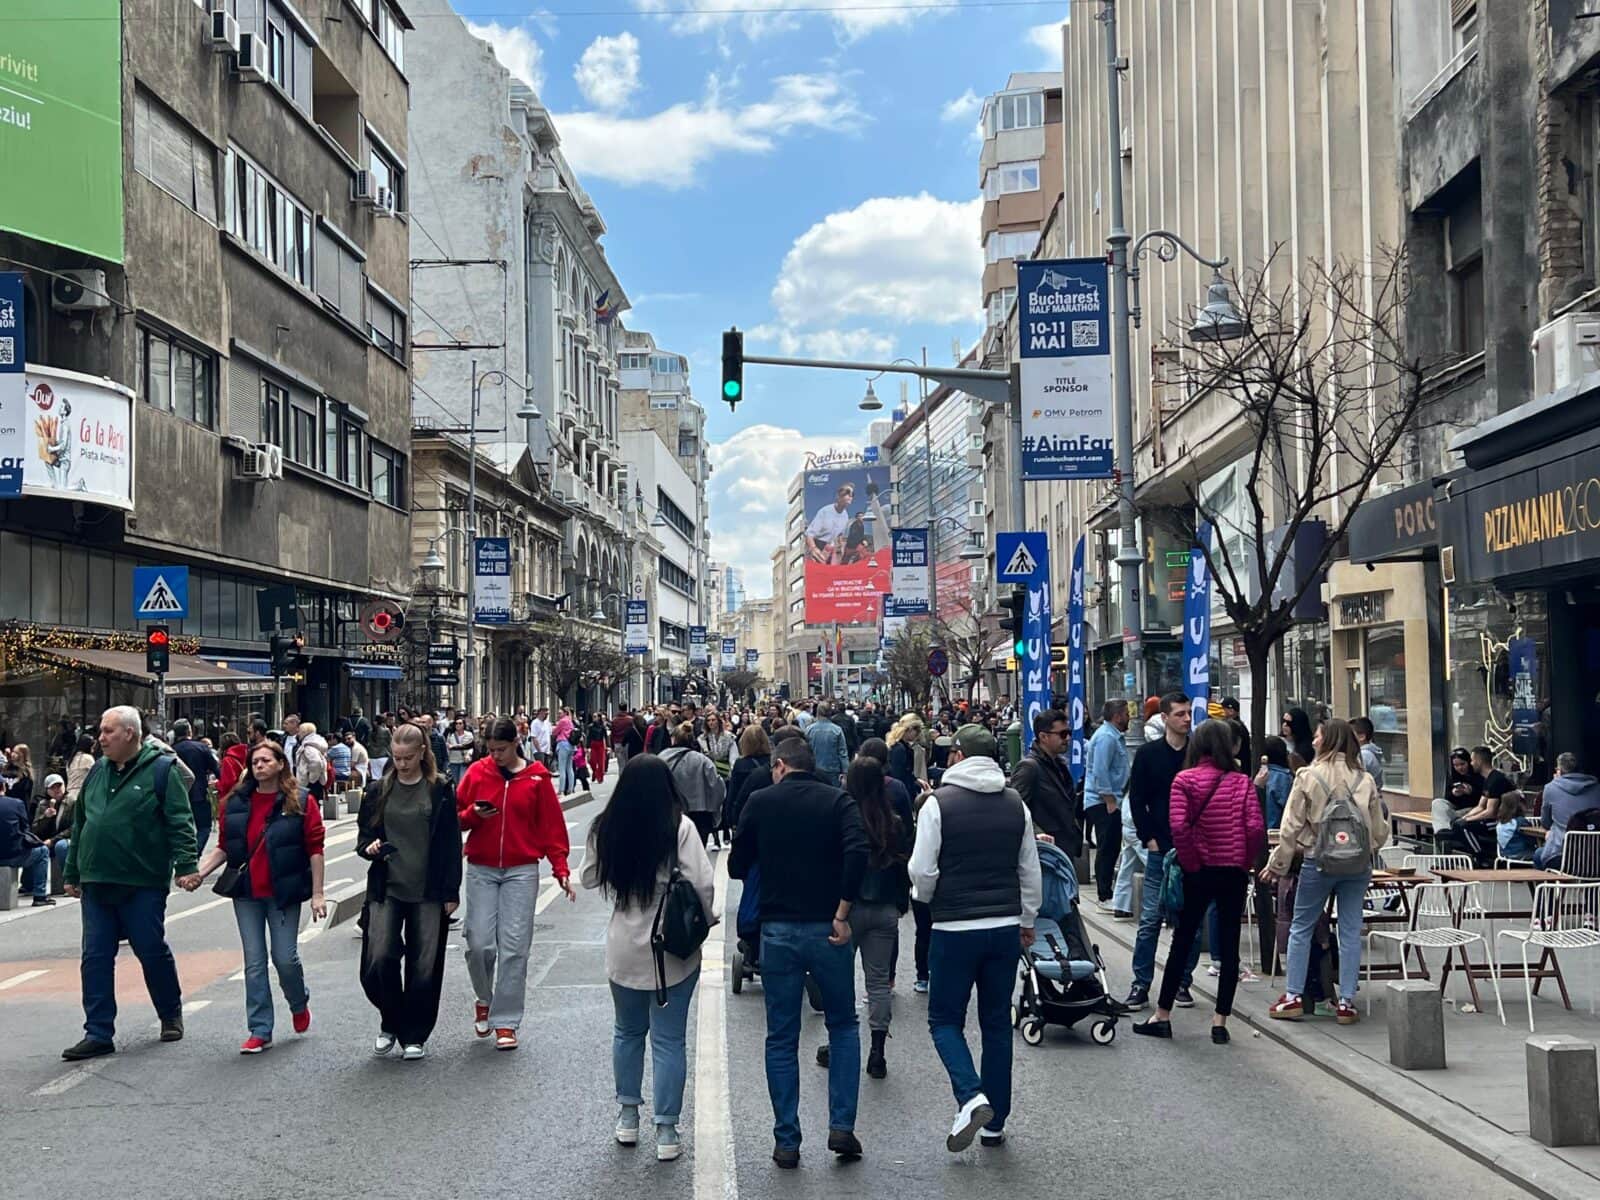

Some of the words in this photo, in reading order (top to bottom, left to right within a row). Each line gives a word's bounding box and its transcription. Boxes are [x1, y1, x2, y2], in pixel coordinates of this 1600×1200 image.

[1028, 291, 1100, 306] Bucharest
[1029, 305, 1050, 314] HALF
[1052, 302, 1100, 313] MARATHON
[1029, 321, 1065, 335] 10-11
[1030, 335, 1066, 350] MAI
[1056, 377, 1076, 385] TITLE
[1043, 385, 1089, 393] SPONSOR
[1044, 409, 1066, 418] OMV
[1069, 408, 1103, 417] Petrom
[1022, 434, 1113, 452] #AimFar
[804, 447, 864, 470] Radisson
[1033, 455, 1103, 463] runinbucharest.com
[1190, 616, 1209, 732] ORC
[1028, 638, 1042, 738] ORC
